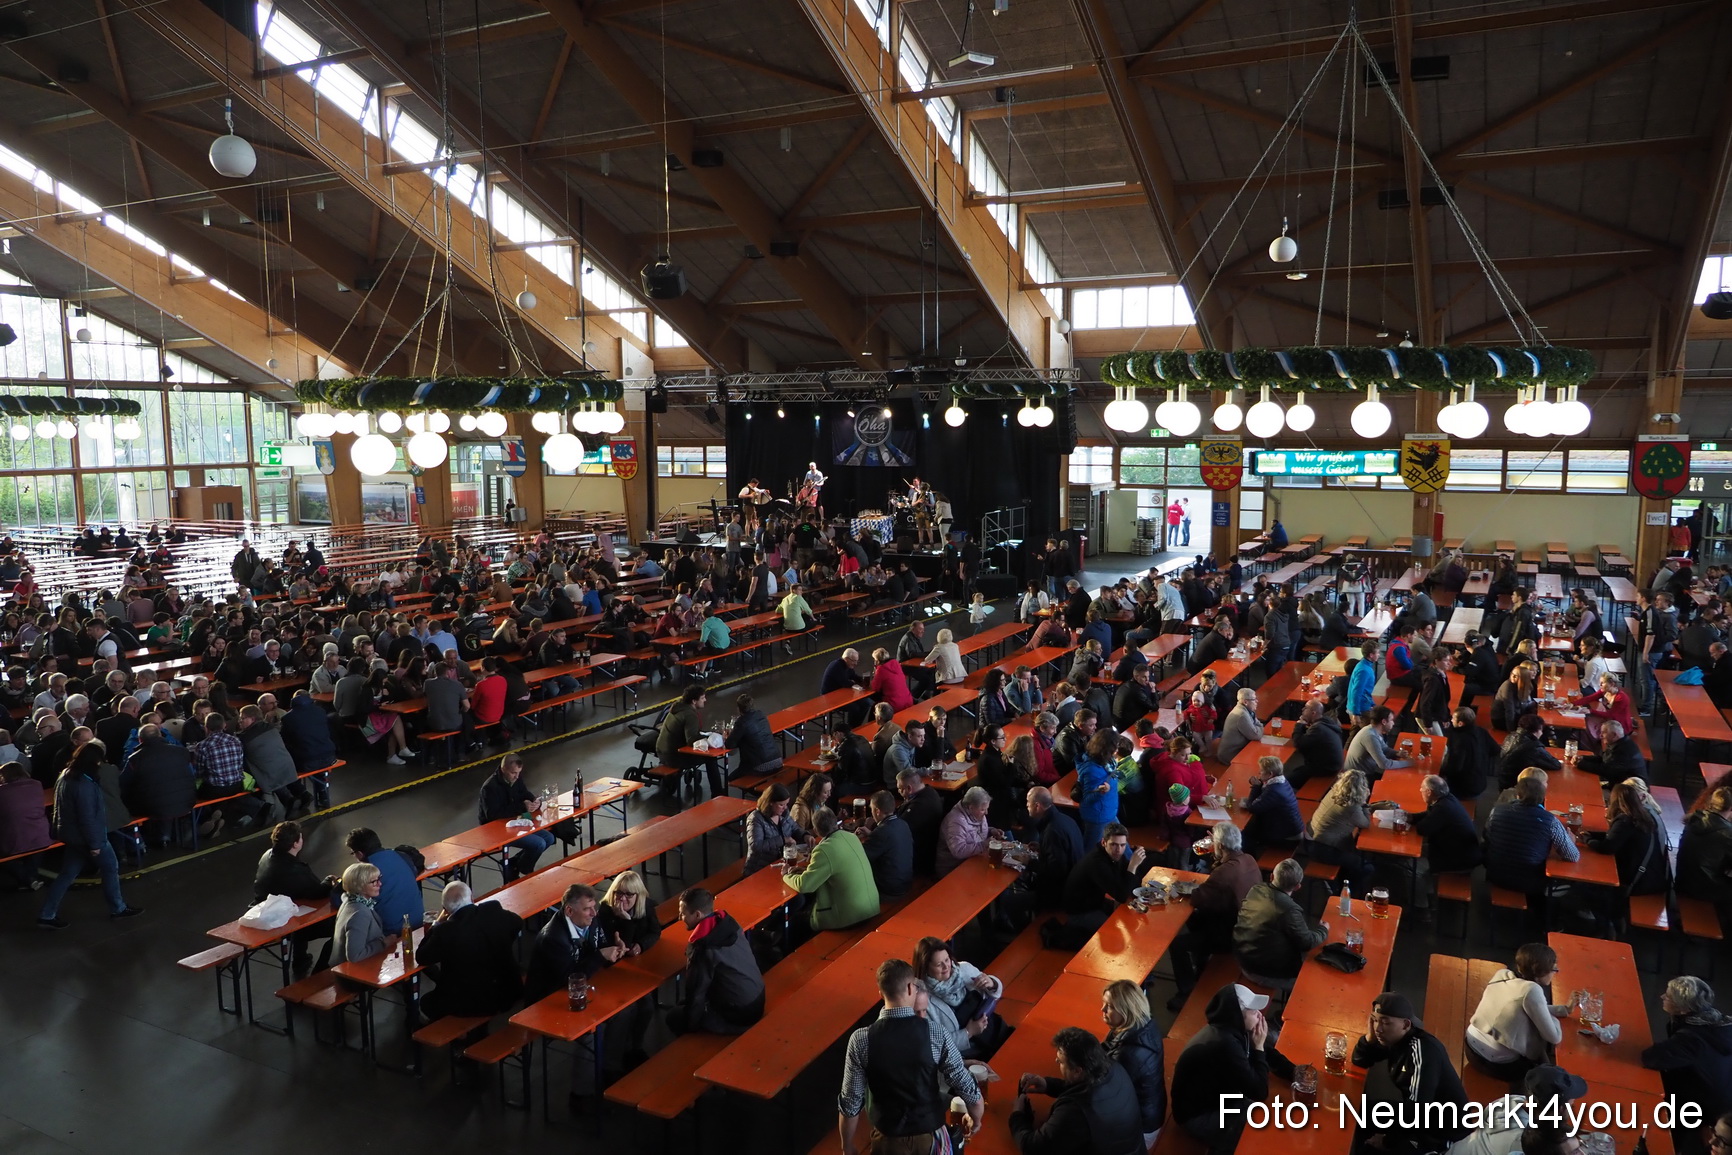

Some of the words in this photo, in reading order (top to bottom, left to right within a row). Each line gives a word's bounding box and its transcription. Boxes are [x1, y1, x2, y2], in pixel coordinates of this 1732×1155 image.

[858, 415, 887, 432] Öha
[1294, 452, 1316, 462] Wir
[1316, 451, 1356, 466] grüßen
[1290, 466, 1324, 474] unsere
[1325, 464, 1359, 474] Gäste!
